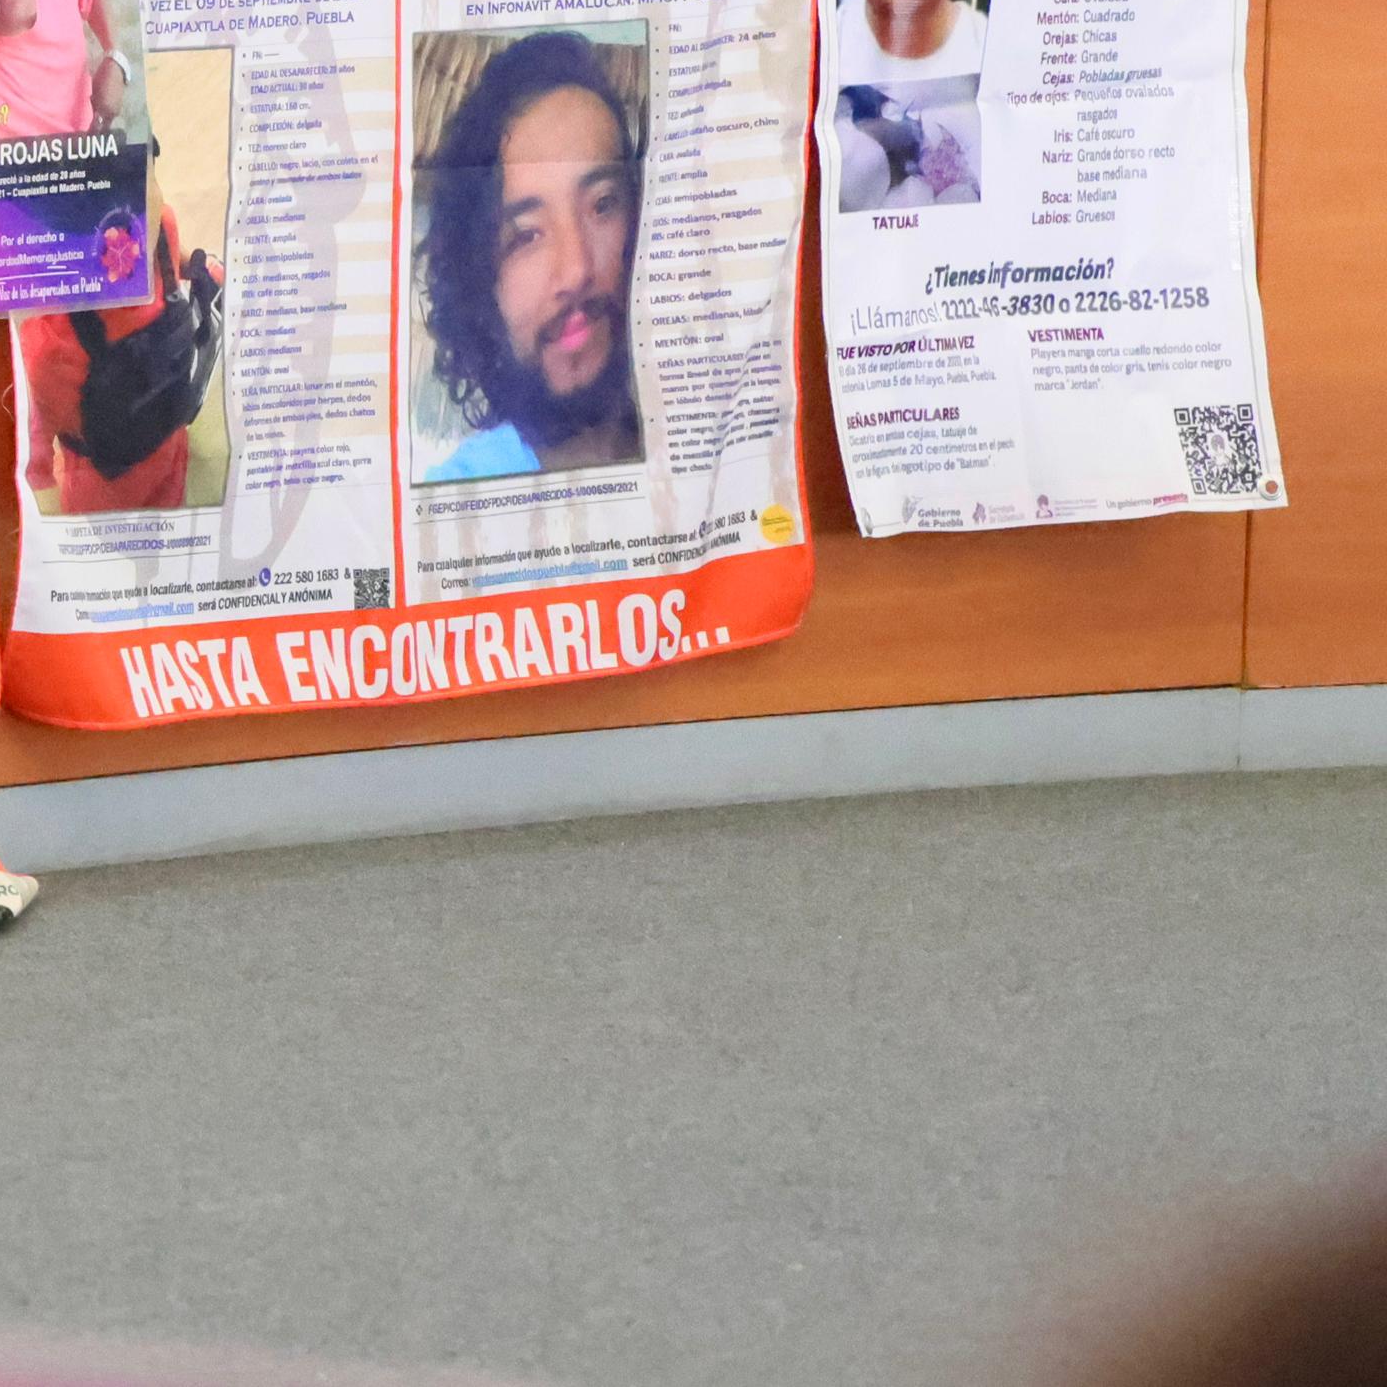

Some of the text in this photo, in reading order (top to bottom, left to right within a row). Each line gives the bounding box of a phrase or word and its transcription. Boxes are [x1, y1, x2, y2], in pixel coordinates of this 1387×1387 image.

[488, 0, 551, 14] INFONAVIT
[307, 11, 354, 25] PUEBLA
[1037, 8, 1135, 25] Mentón: Cuadrado
[1043, 30, 1117, 48] Orejas: Chicas
[1041, 49, 1118, 64] Frente: Grande
[1043, 72, 1073, 88] Cejas:
[0, 138, 63, 166] ROJAS
[67, 133, 119, 160] LUNA
[1043, 149, 1072, 163] Nariz:
[1042, 191, 1072, 204] Boca:
[1032, 211, 1071, 225] Labios:
[926, 257, 1114, 295] ¿Tienes información?
[1028, 328, 1104, 342] VESTIMENTA
[858, 344, 892, 358] VISTO
[958, 335, 974, 349] VEZ
[317, 569, 339, 582] 1683
[121, 630, 270, 717] HASTA
